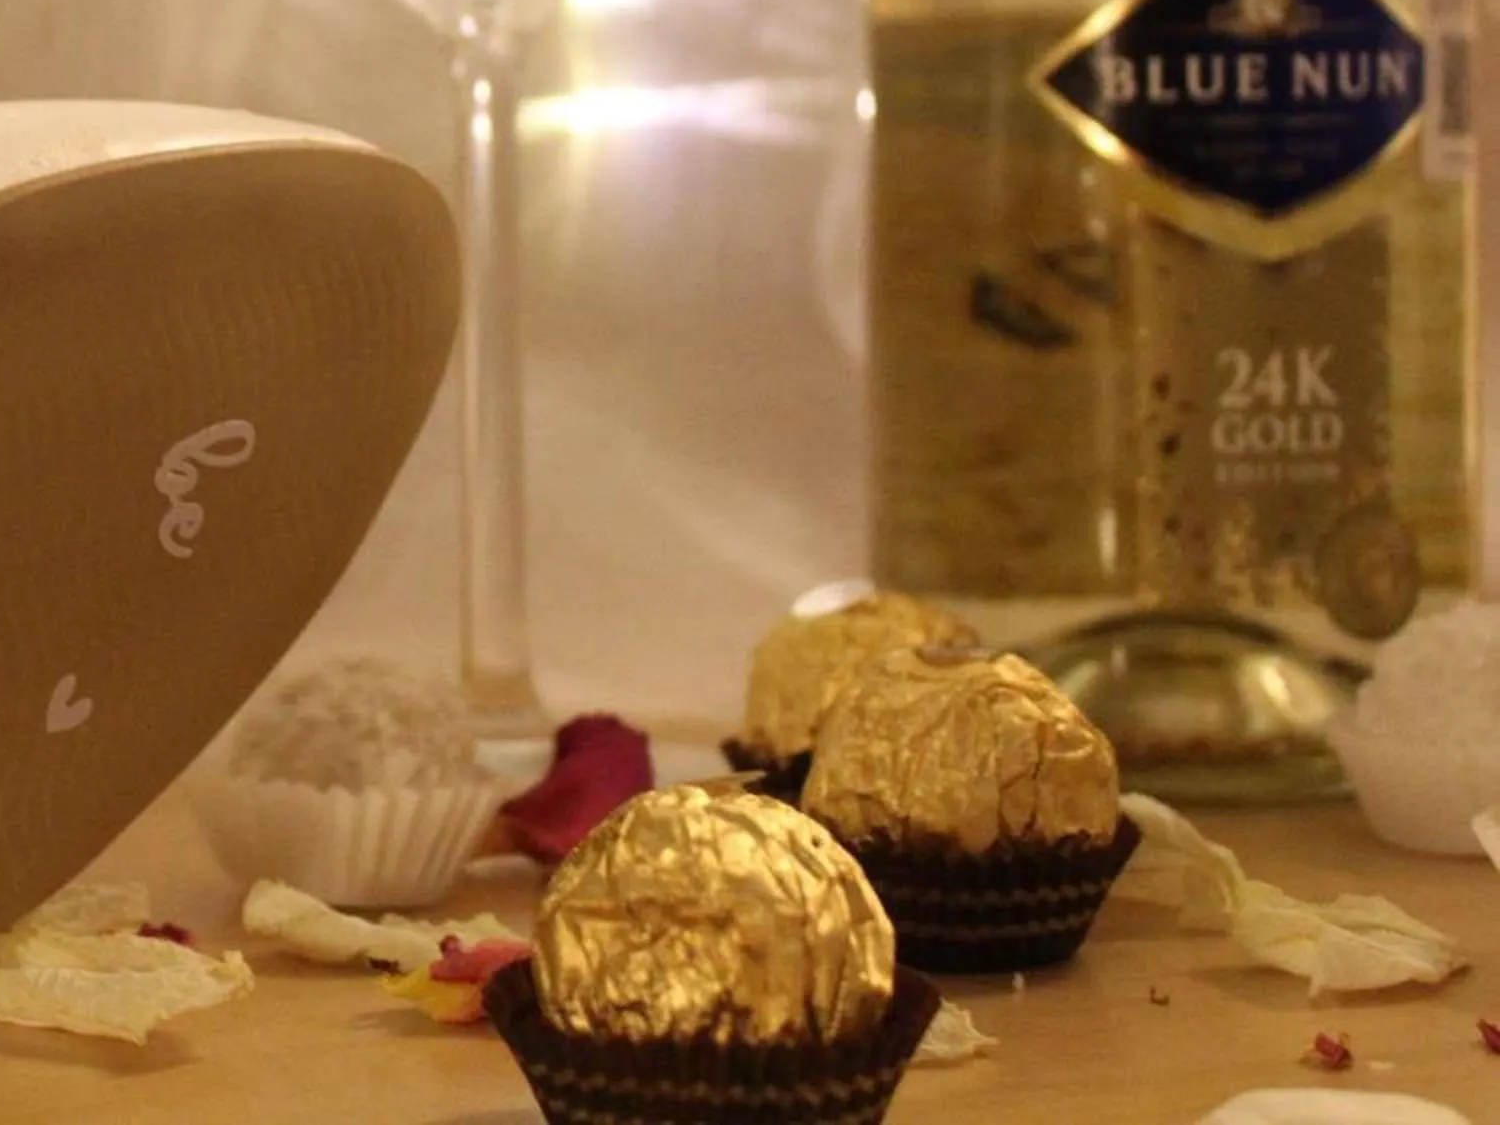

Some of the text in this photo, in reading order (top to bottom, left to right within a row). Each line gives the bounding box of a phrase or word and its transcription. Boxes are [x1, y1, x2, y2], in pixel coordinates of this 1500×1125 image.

[1100, 49, 1409, 103] BLUE NUN
[1211, 412, 1344, 454] GOLD
[154, 419, 256, 558] be
